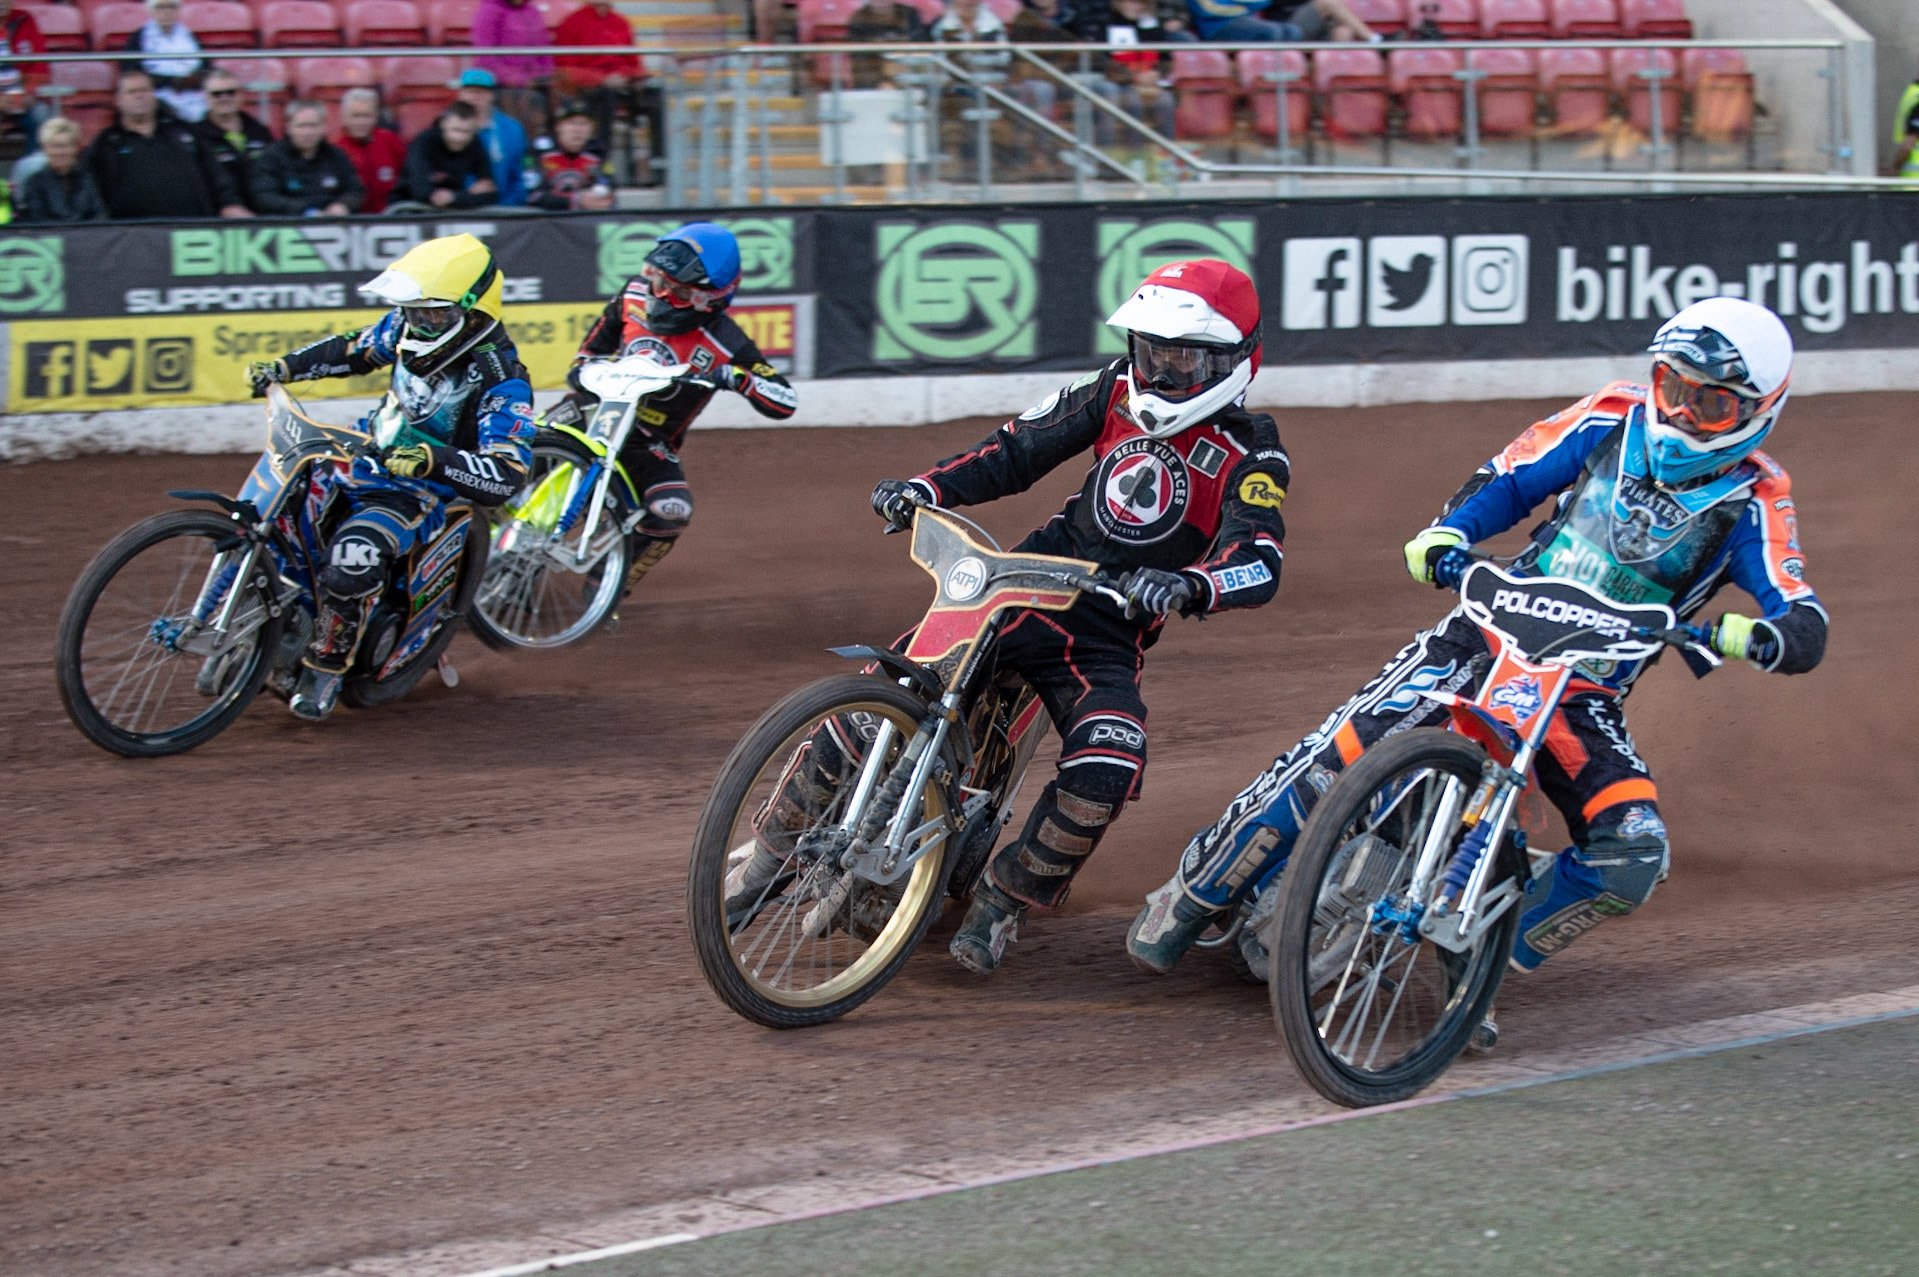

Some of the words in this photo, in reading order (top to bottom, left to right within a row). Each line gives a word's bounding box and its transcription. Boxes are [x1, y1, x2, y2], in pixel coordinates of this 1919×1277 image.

[172, 224, 497, 276] BIKERIG
[126, 284, 347, 313] SUPPORTING
[1114, 440, 1149, 460] BELLE
[1153, 445, 1178, 467] VUE
[1172, 471, 1186, 506] ACES
[1099, 506, 1141, 536] MANCESTER
[1620, 478, 1687, 523] PIRATES
[1490, 588, 1633, 641] POLCOPPER
